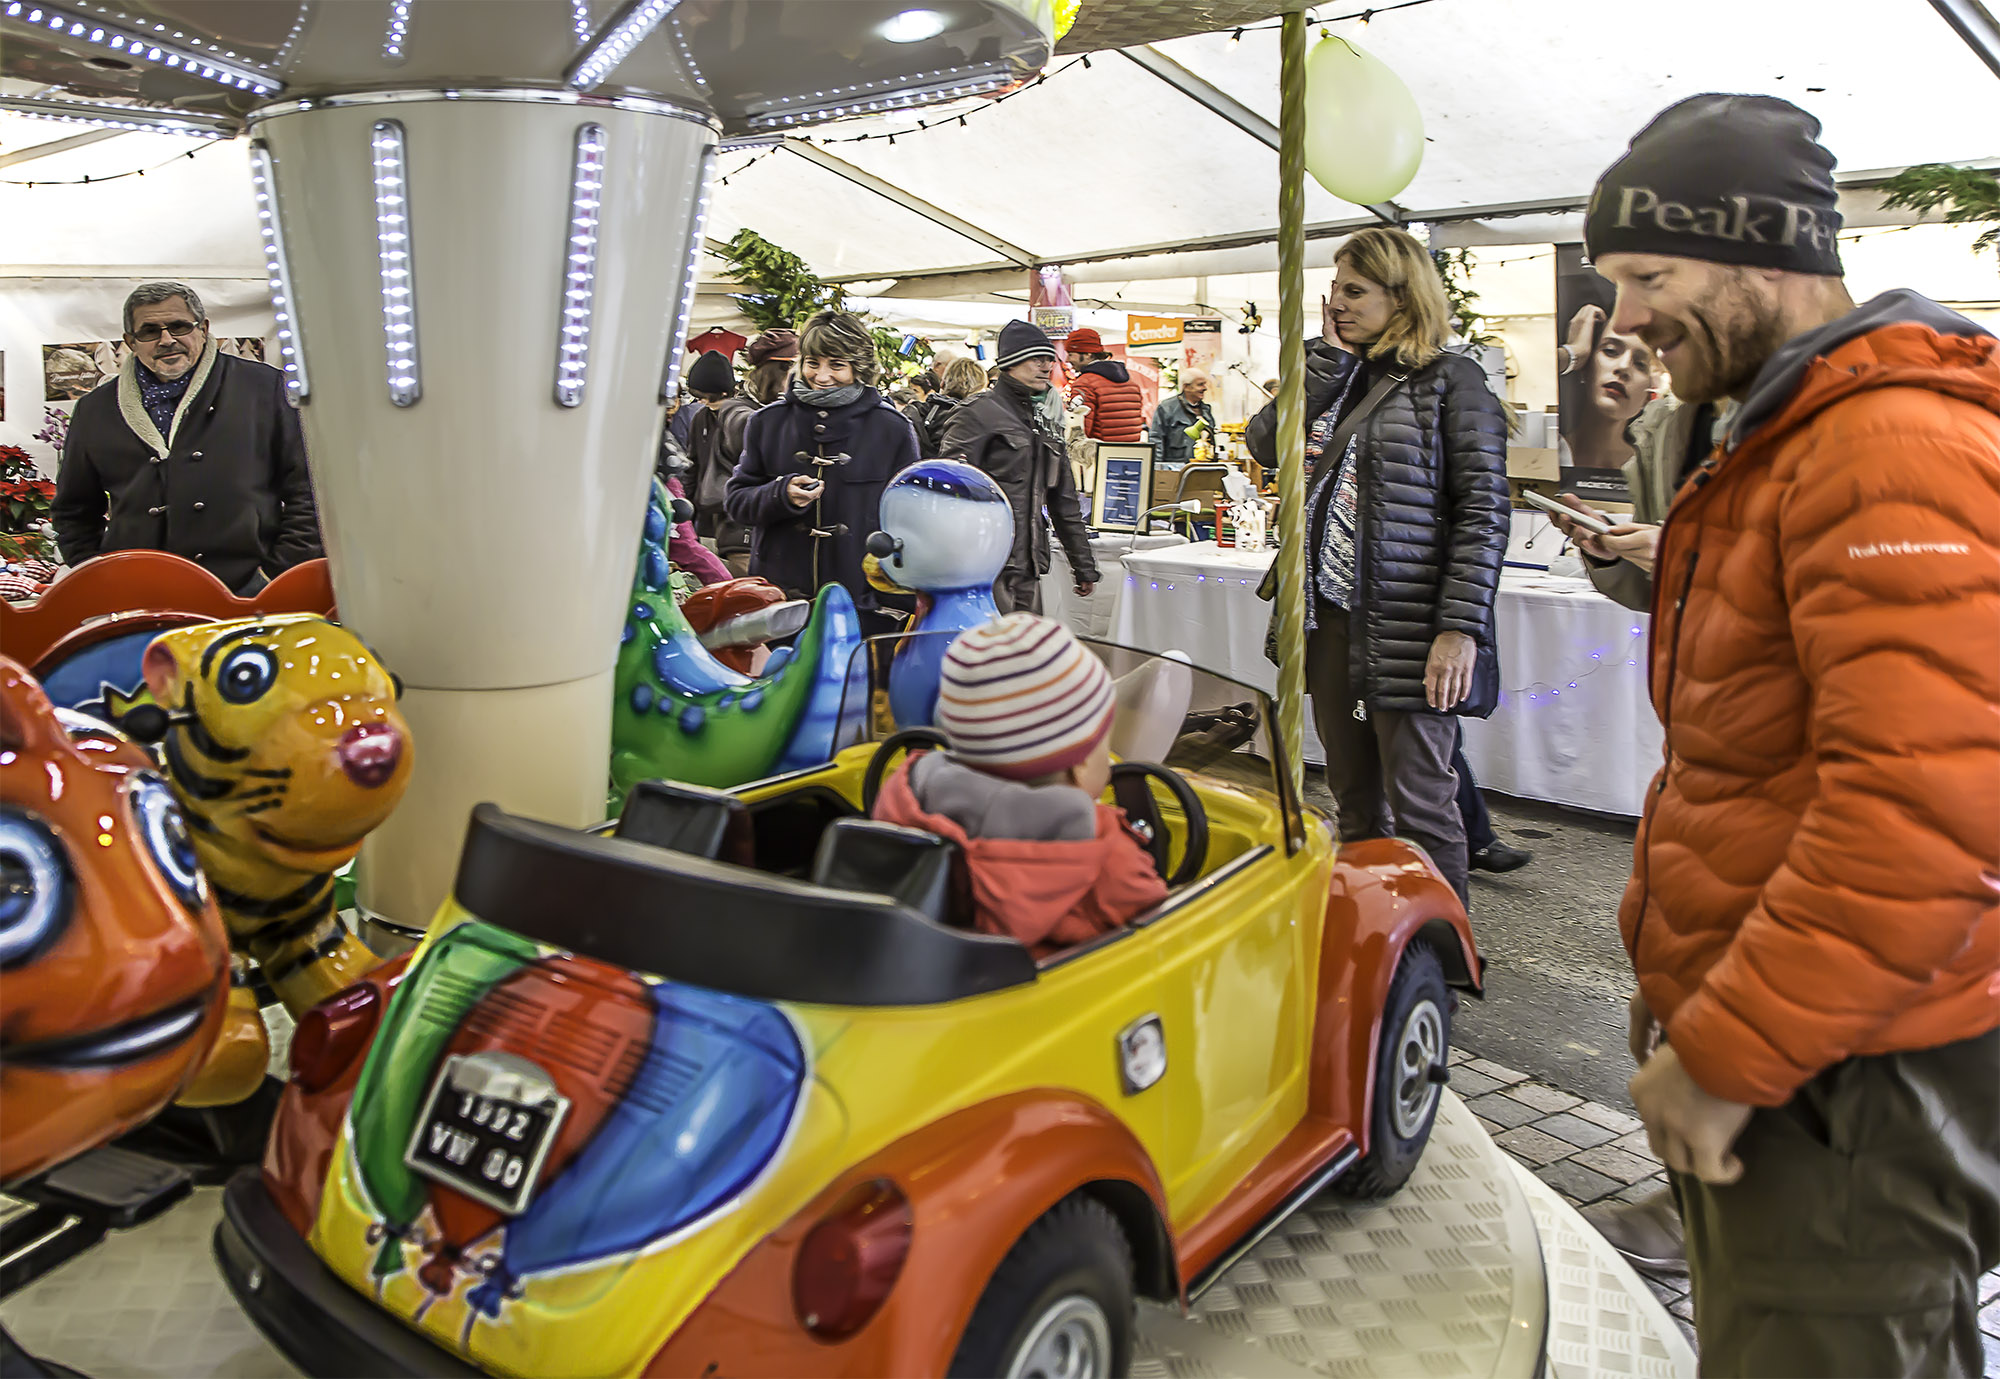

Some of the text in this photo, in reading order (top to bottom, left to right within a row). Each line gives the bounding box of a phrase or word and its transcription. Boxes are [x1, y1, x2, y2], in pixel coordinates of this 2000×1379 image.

[1611, 187, 1836, 252] Peak Pe
[1130, 322, 1178, 341] demeter
[430, 1121, 479, 1165] VW
